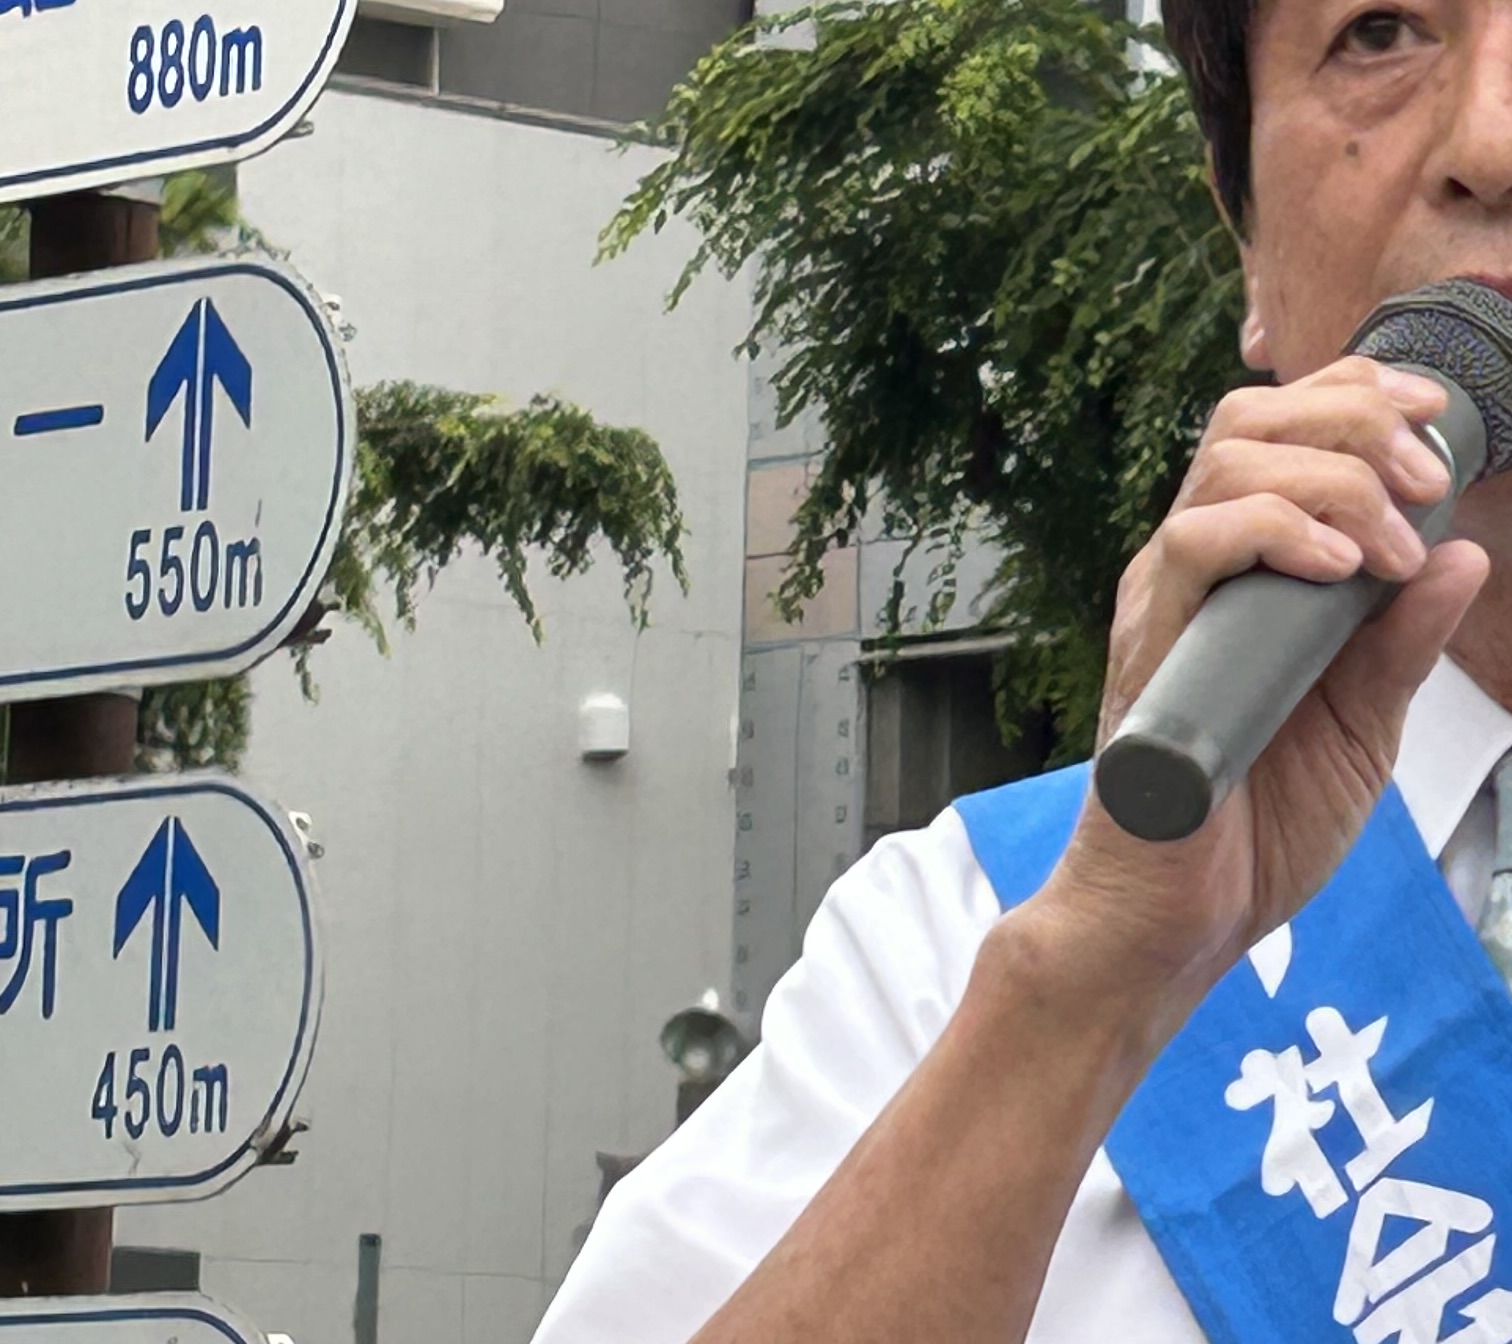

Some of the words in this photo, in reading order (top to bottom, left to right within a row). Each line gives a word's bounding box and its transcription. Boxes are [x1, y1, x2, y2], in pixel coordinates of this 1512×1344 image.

[128, 14, 262, 114] 880m
[126, 520, 262, 620] 550m
[0, 849, 73, 1019] 所
[91, 1044, 229, 1140] 450m
